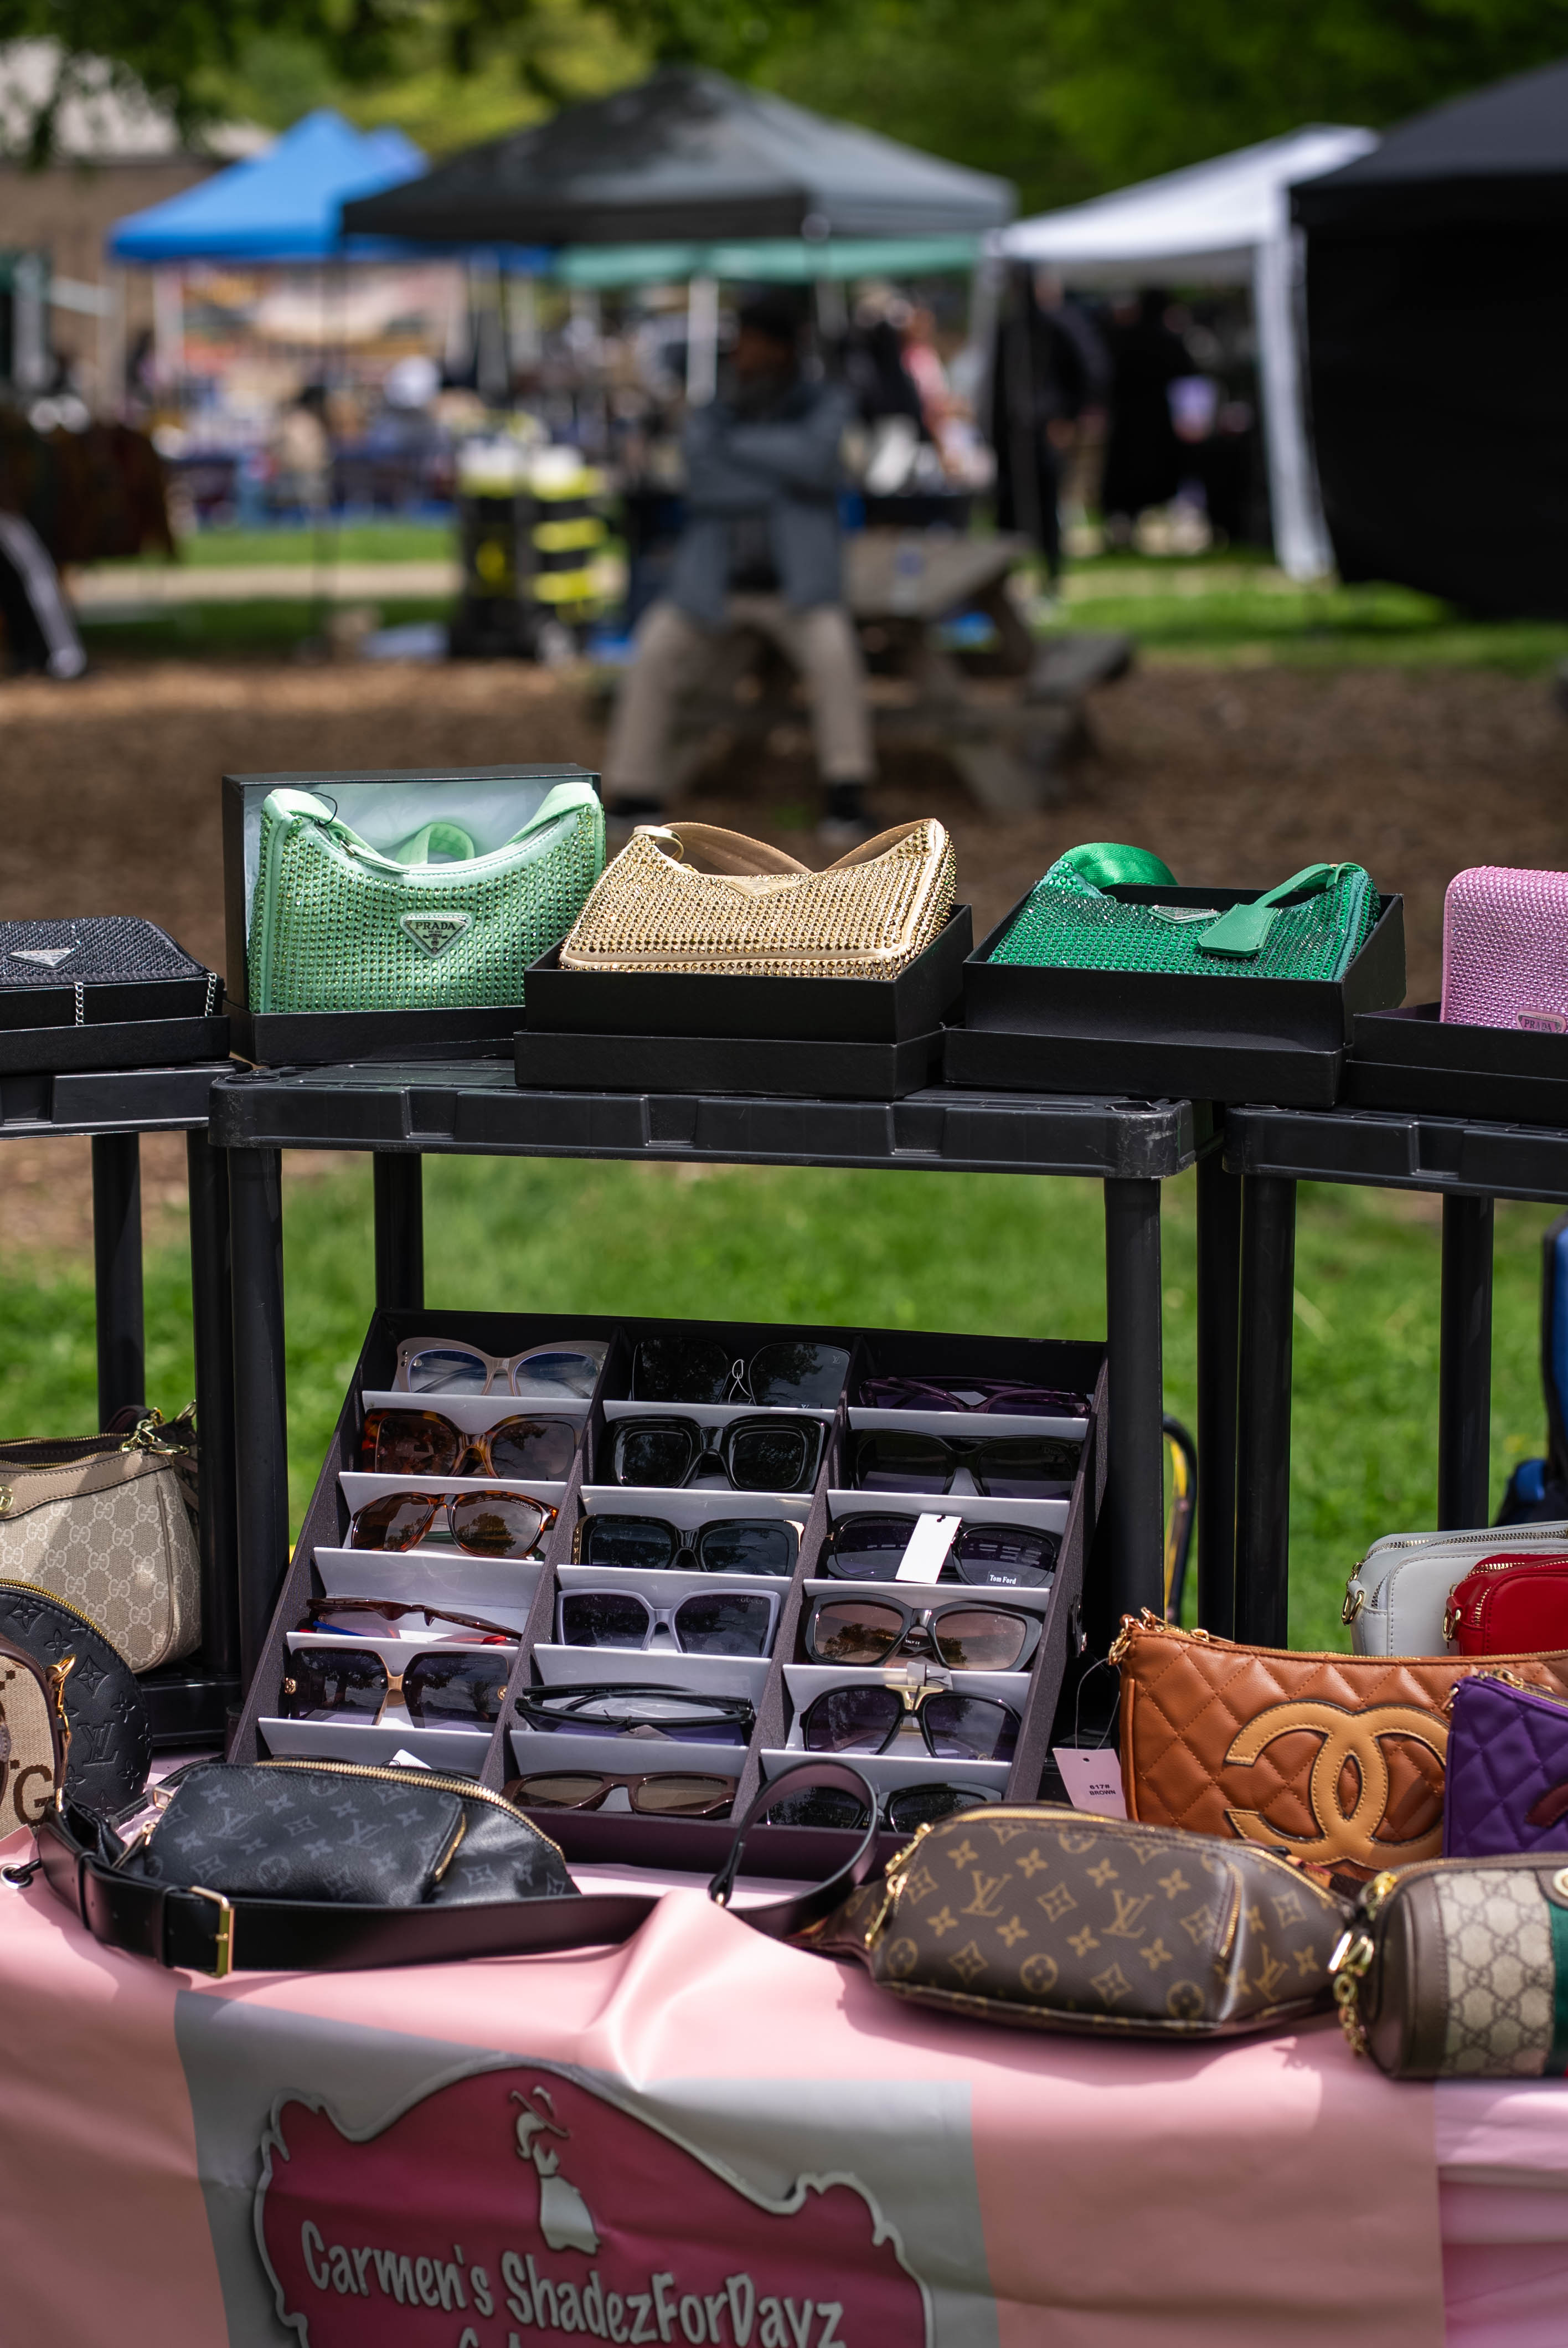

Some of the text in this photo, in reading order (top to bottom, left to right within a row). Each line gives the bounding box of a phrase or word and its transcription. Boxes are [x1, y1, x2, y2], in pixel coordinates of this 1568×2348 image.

[415, 921, 456, 930] PRADA
[1002, 1576, 1017, 1584] Ford
[301, 2220, 846, 2348] Carmen's ShadezForDayz
